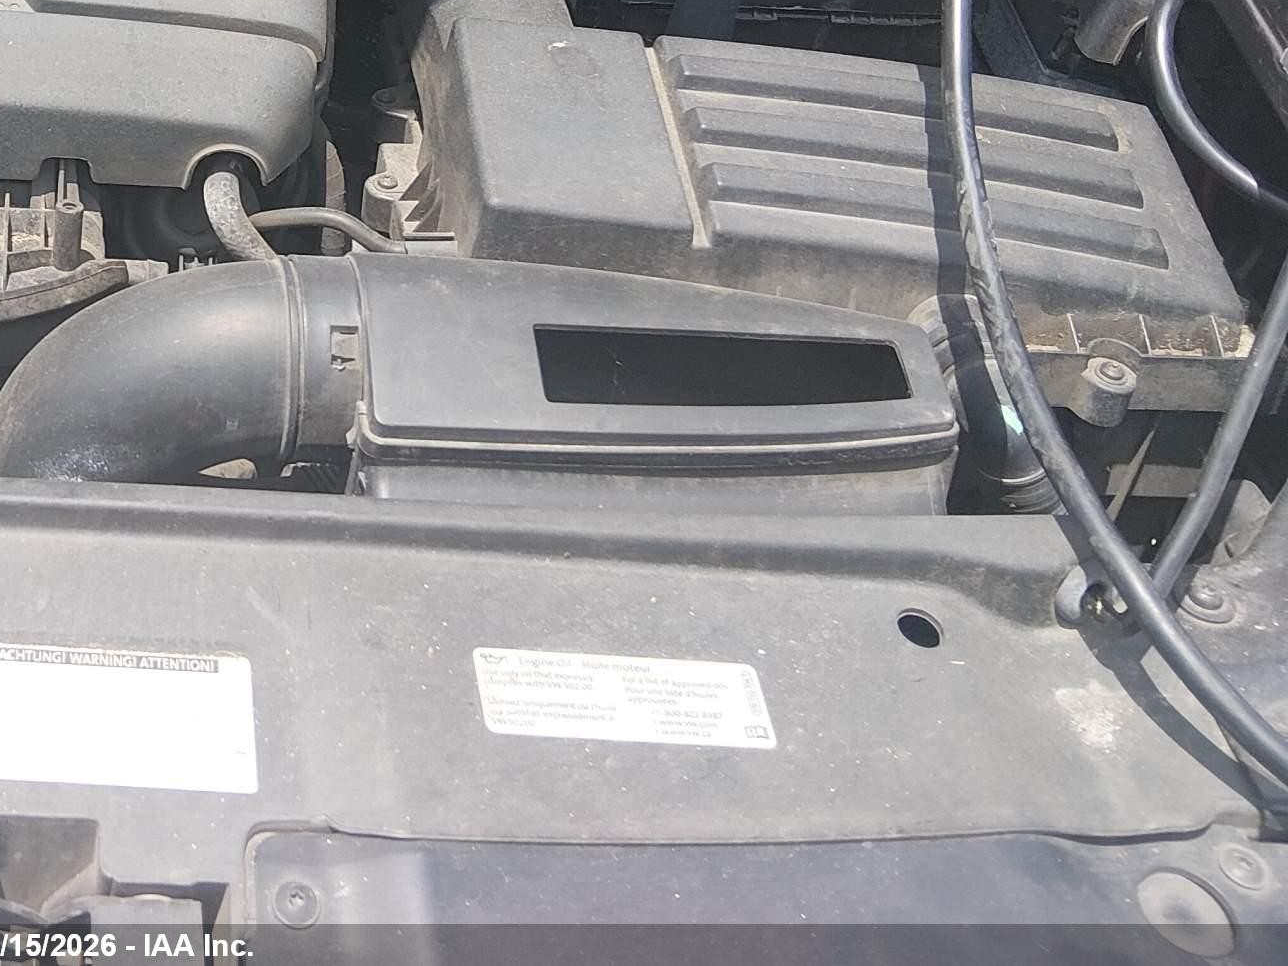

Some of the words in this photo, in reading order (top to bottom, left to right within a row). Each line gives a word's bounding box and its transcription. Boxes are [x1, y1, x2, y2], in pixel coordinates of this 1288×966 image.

[69, 651, 137, 667] WARNING!
[139, 655, 215, 672] ATTENTION!
[519, 656, 554, 668] Engine
[613, 663, 651, 673] moteur
